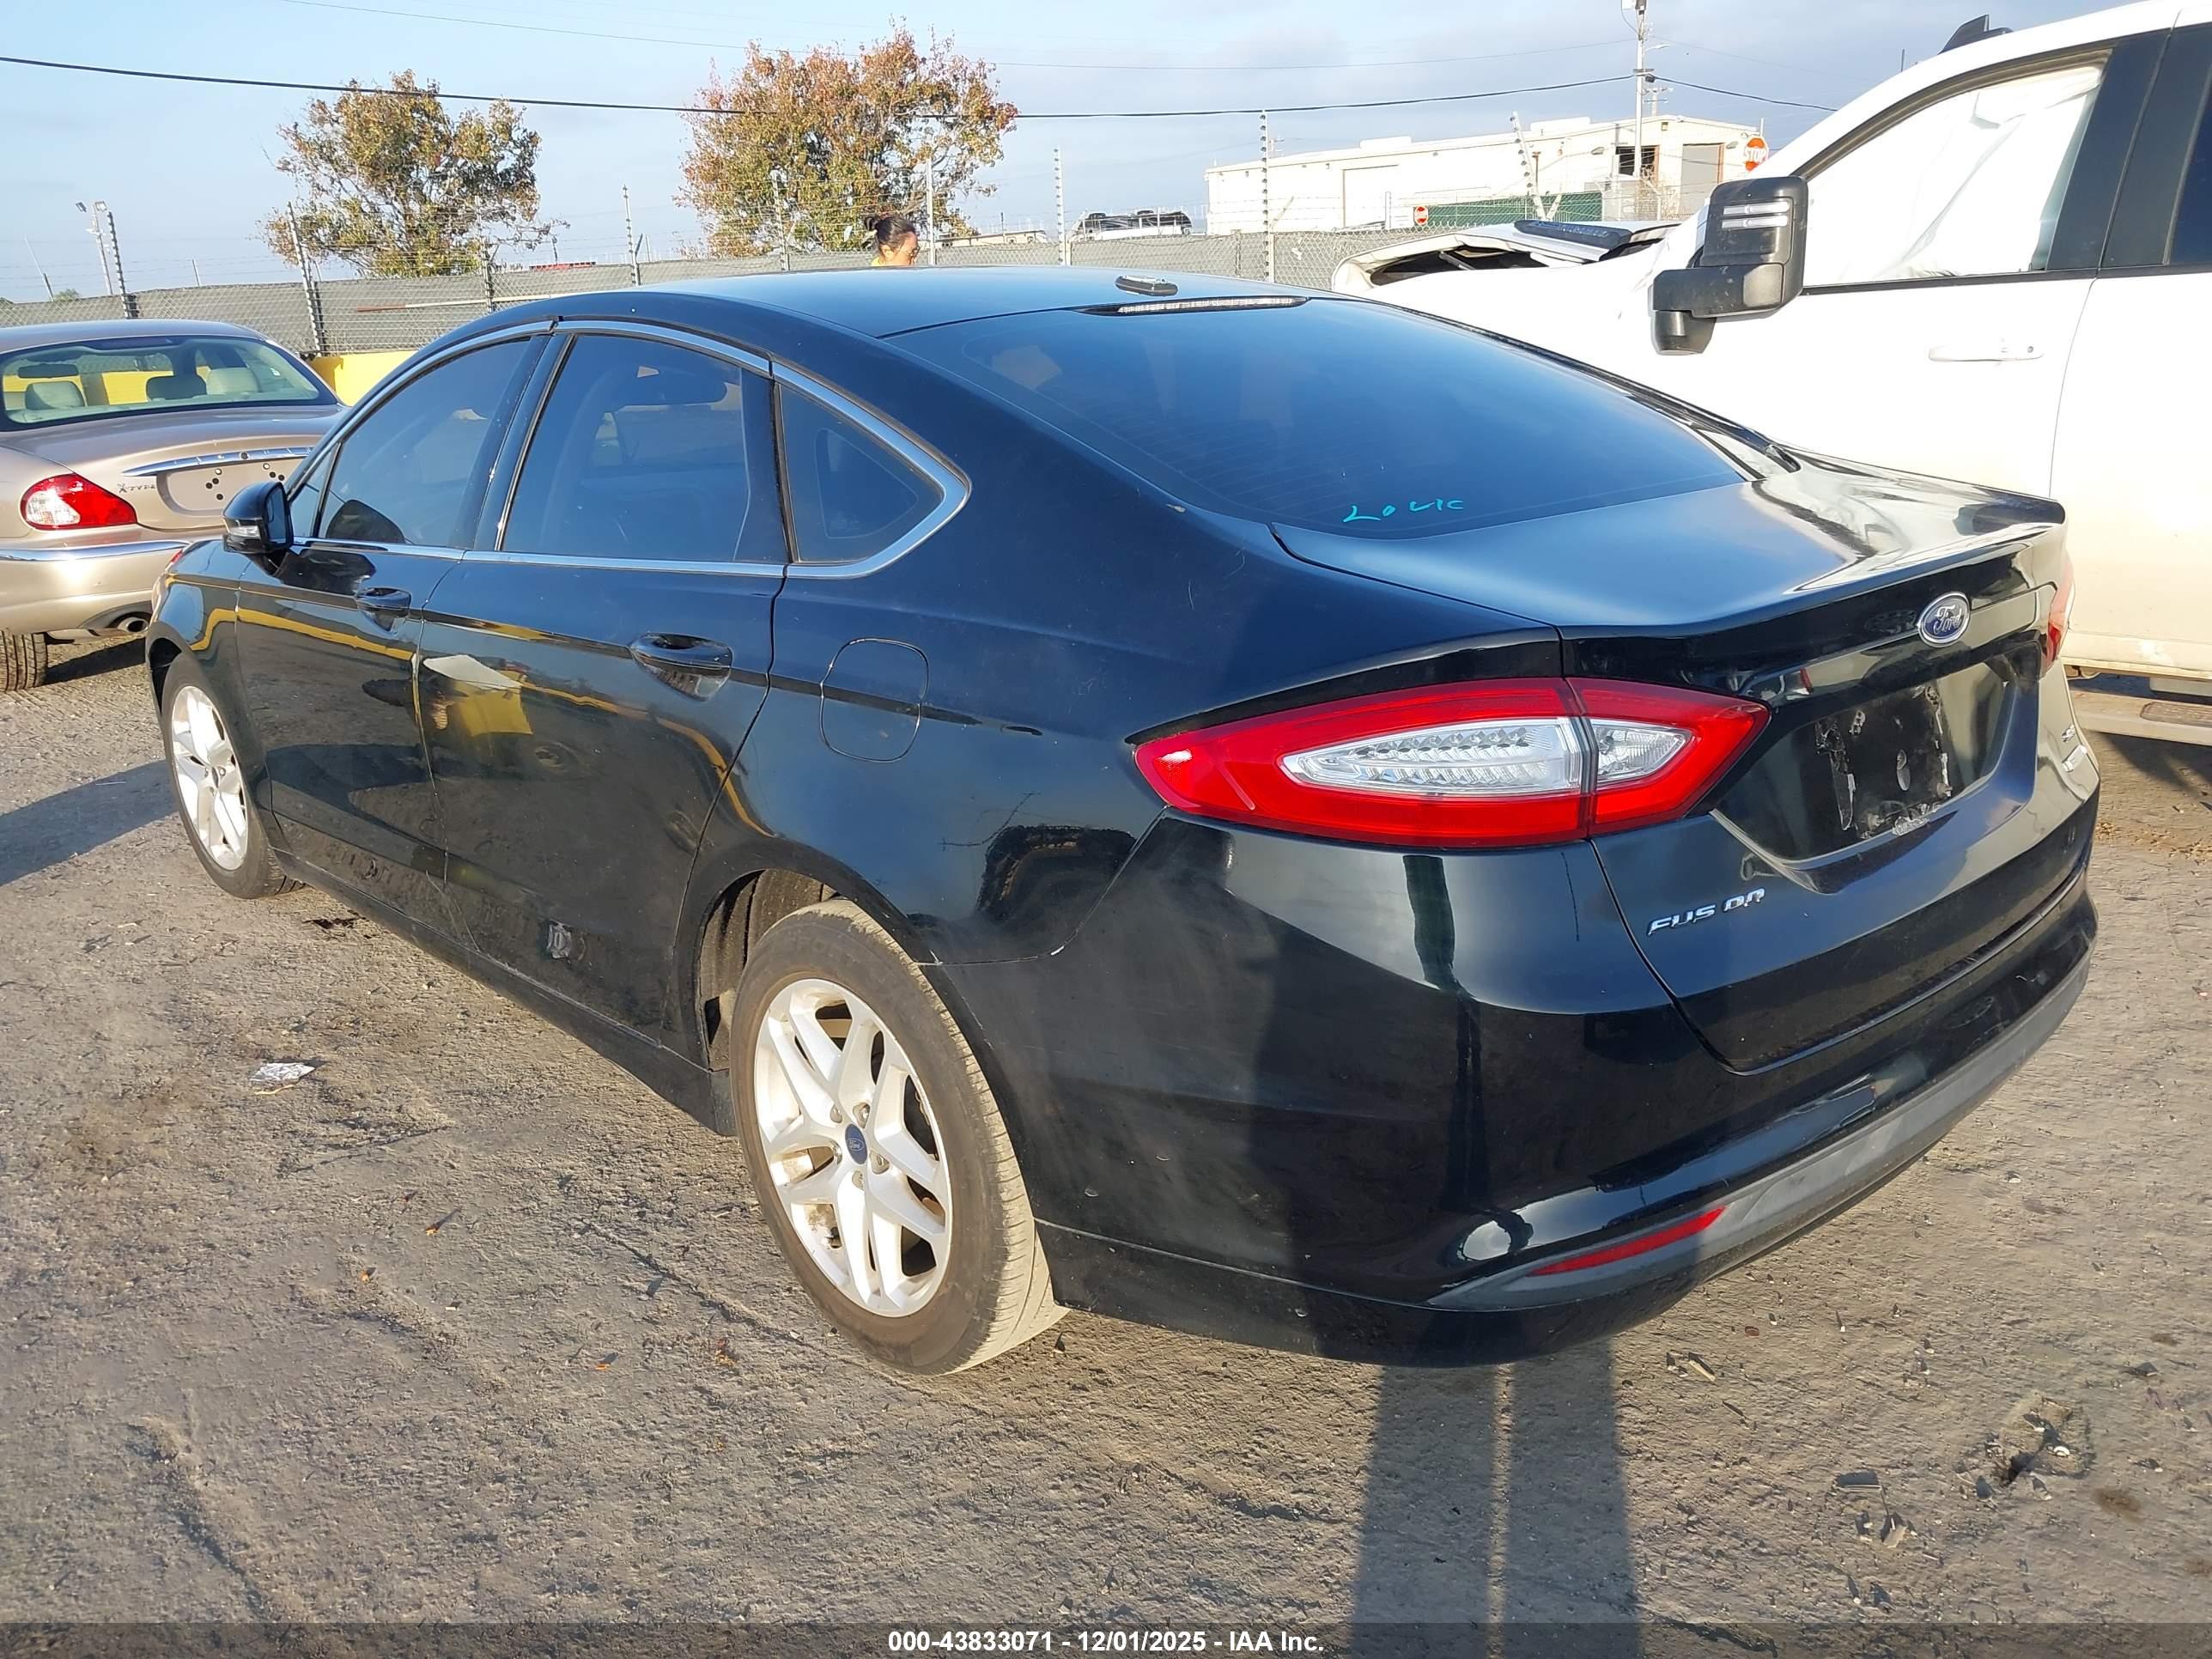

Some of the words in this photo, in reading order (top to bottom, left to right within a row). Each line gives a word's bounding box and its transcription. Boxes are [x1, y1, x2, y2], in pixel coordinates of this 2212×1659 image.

[1743, 146, 1769, 161] STOP
[1932, 604, 1962, 635] Ford
[1648, 887, 1765, 936] FUSON
